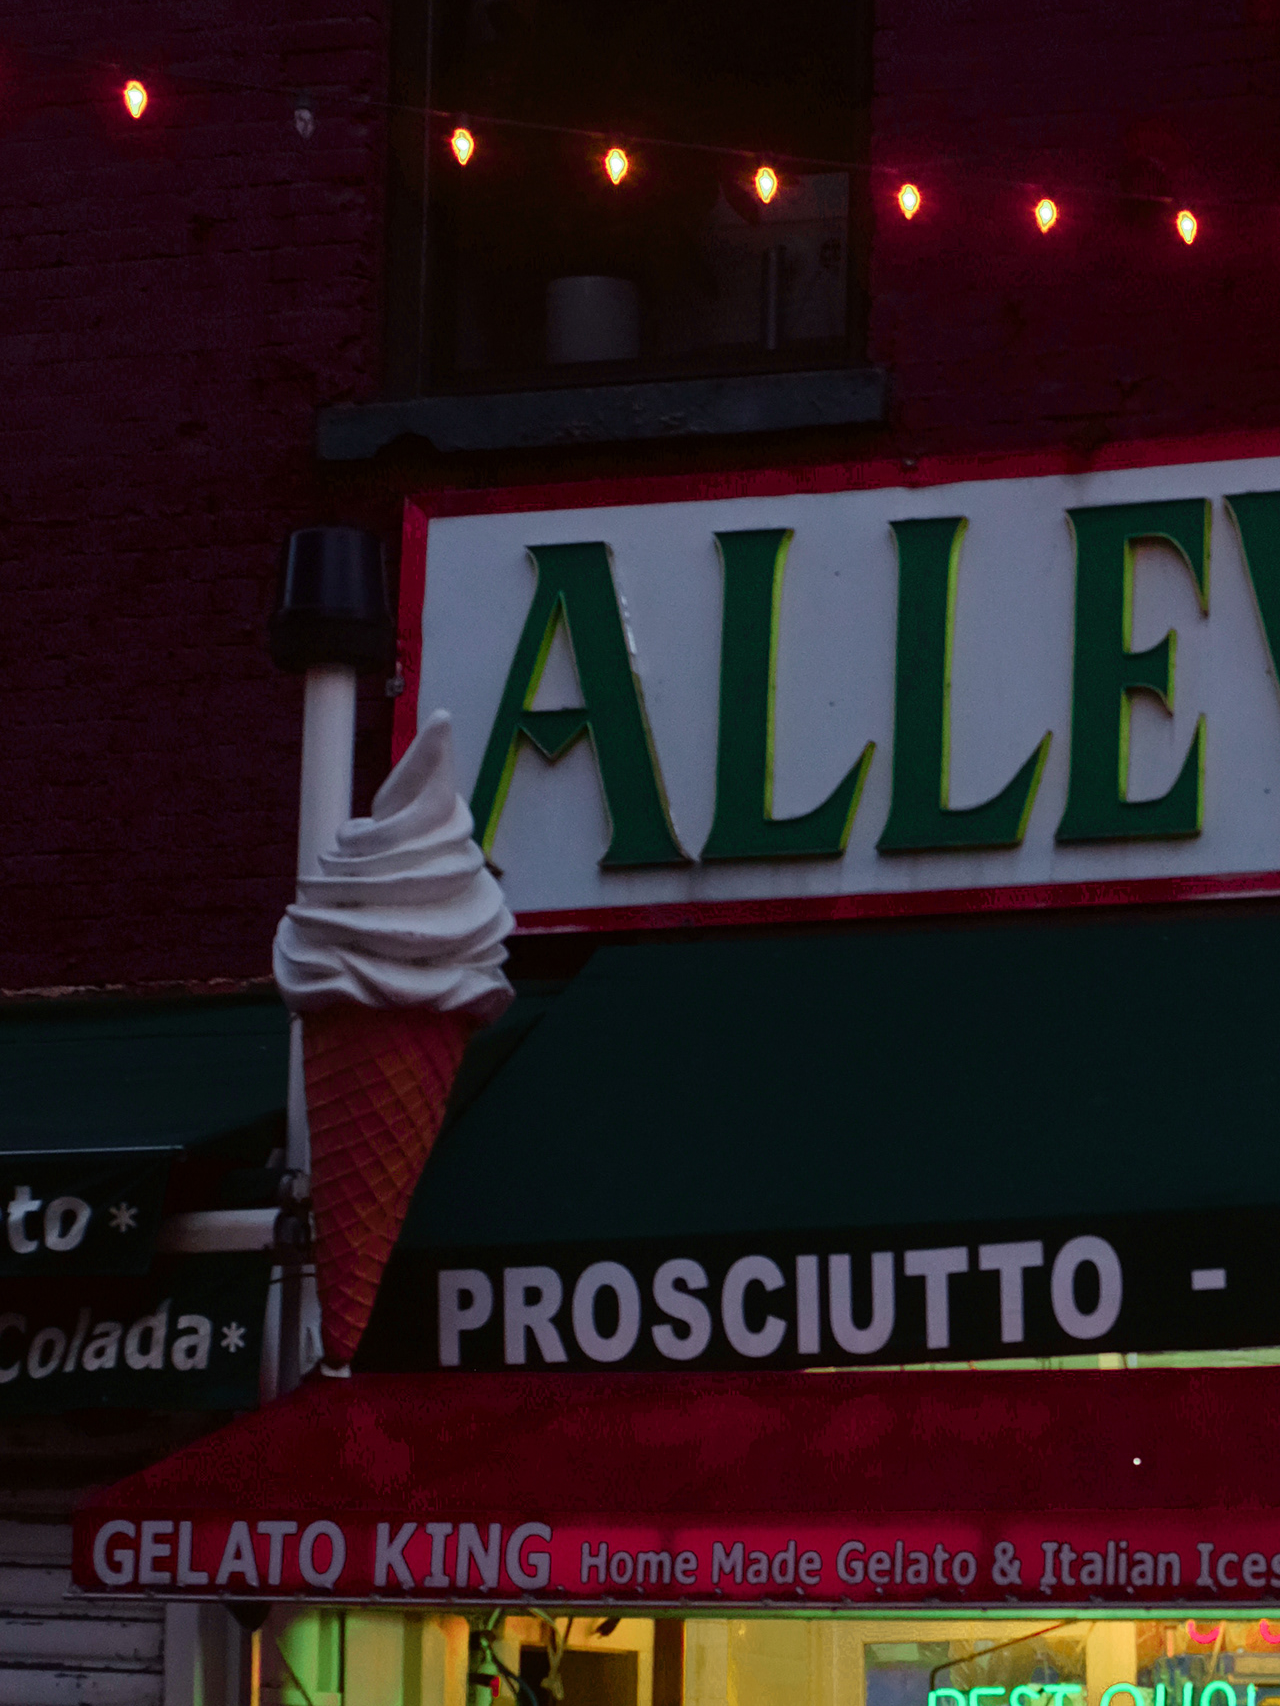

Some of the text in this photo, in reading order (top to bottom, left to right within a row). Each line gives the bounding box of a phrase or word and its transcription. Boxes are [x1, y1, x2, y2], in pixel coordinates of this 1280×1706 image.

[0, 1184, 93, 1254] to
[437, 1234, 1124, 1368] PROSCIUTTO
[92, 1519, 347, 1591] GELATO
[373, 1521, 552, 1590] KING
[580, 1542, 698, 1586] Home
[710, 1540, 826, 1588] Made
[836, 1540, 978, 1589] Gelato
[991, 1542, 1022, 1587] &
[1039, 1540, 1182, 1589] Italian
